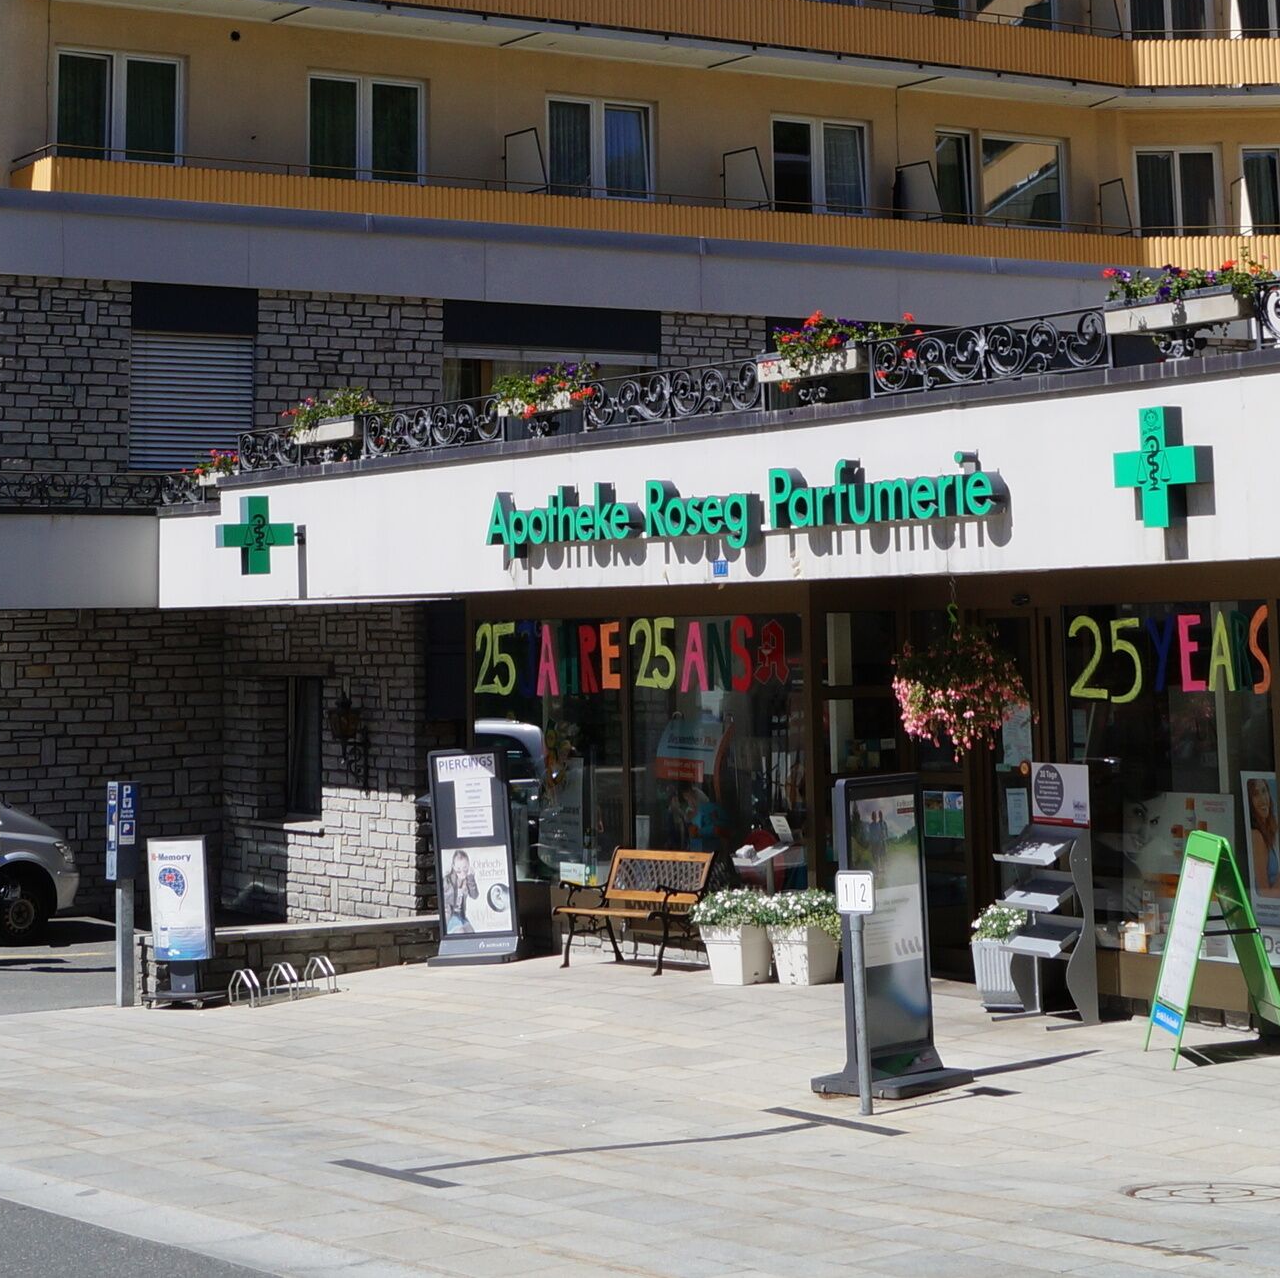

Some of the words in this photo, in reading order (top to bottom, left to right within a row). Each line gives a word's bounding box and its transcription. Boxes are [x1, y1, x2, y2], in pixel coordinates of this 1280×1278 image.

[486, 482, 629, 559] Apotheke
[646, 480, 748, 549] Roseg
[769, 451, 993, 529] Parfumerie
[474, 622, 517, 696] 25
[517, 620, 621, 698] JAHRE
[629, 616, 677, 690] 25
[680, 615, 754, 693] ANS
[1068, 615, 1143, 703] 25
[1146, 605, 1272, 694] YEARS
[123, 785, 131, 798] P
[438, 755, 493, 771] PIERCINGS
[844, 883, 849, 902] 1
[860, 883, 867, 903] 2
